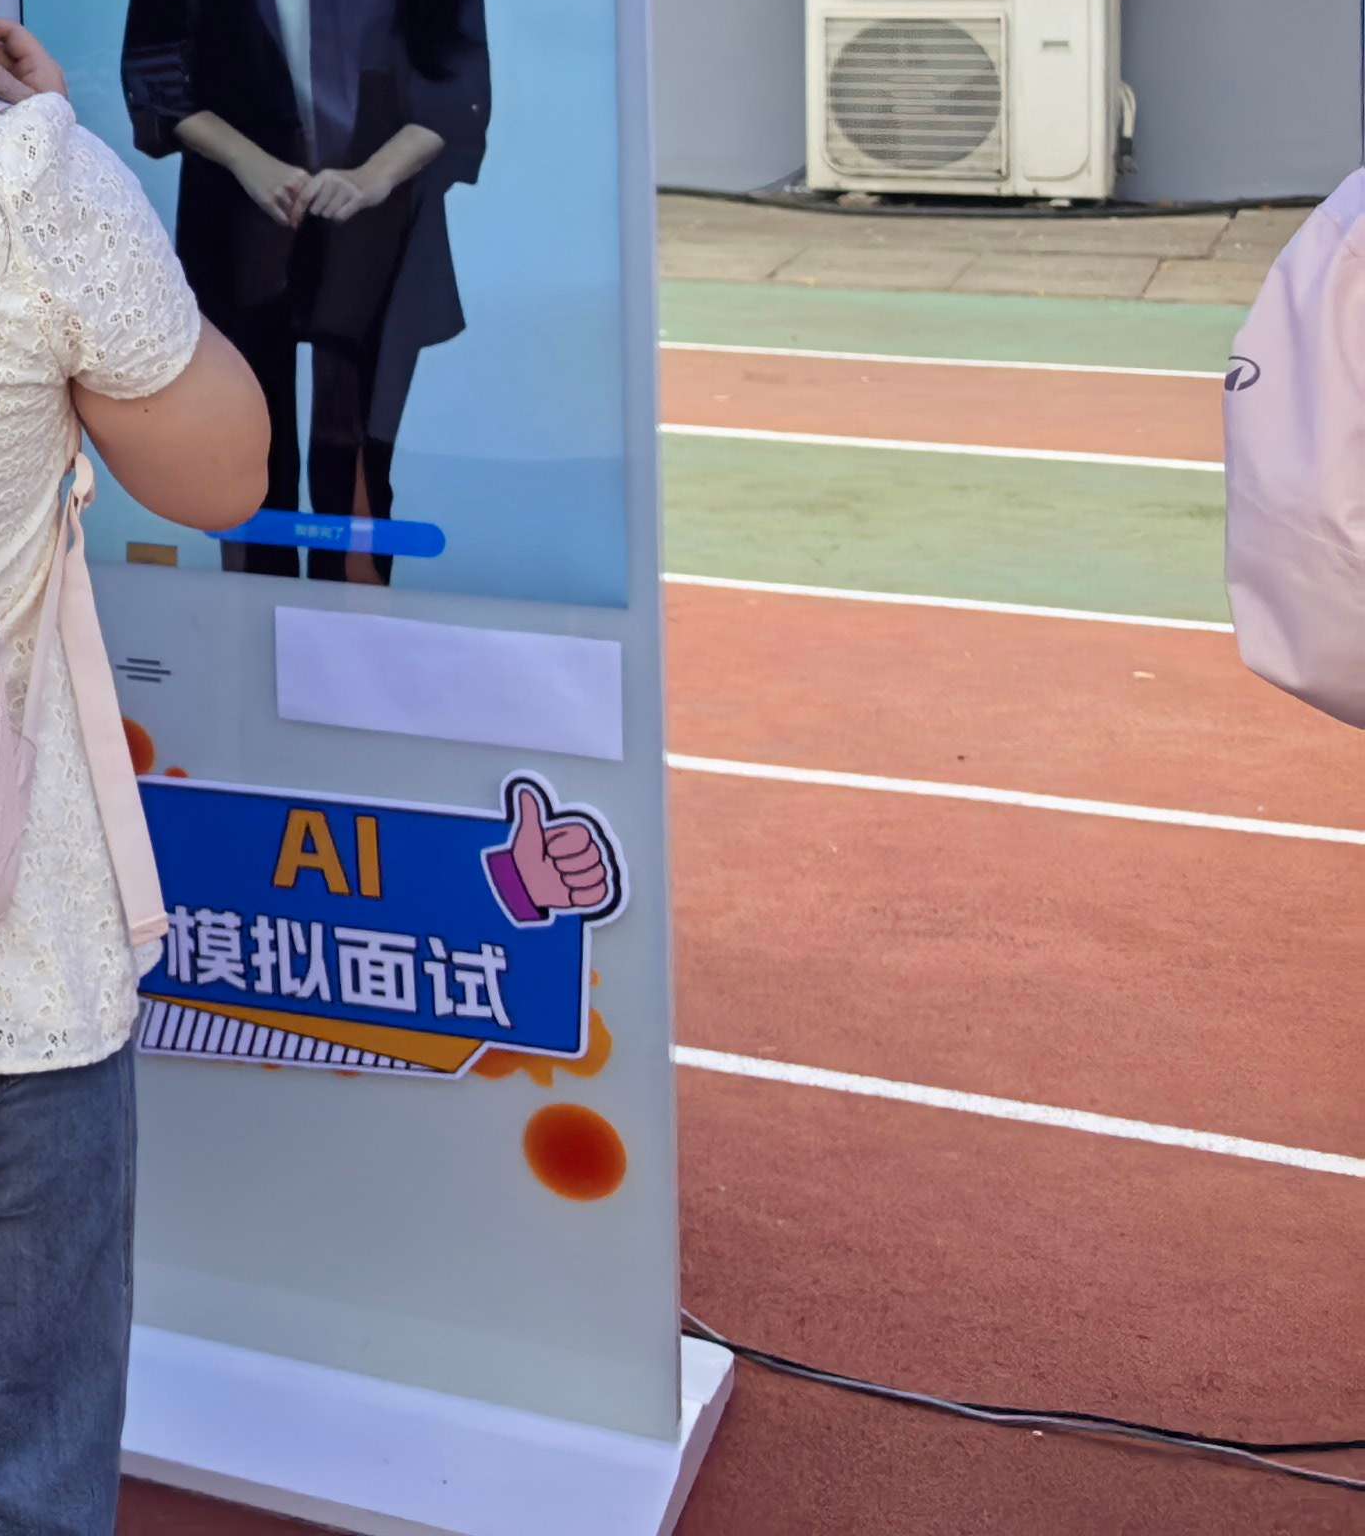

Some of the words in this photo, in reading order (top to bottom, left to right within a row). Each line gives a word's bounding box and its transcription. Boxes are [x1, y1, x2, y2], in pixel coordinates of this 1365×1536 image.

[273, 808, 382, 899] AI
[166, 904, 512, 1028] 模拟面试
